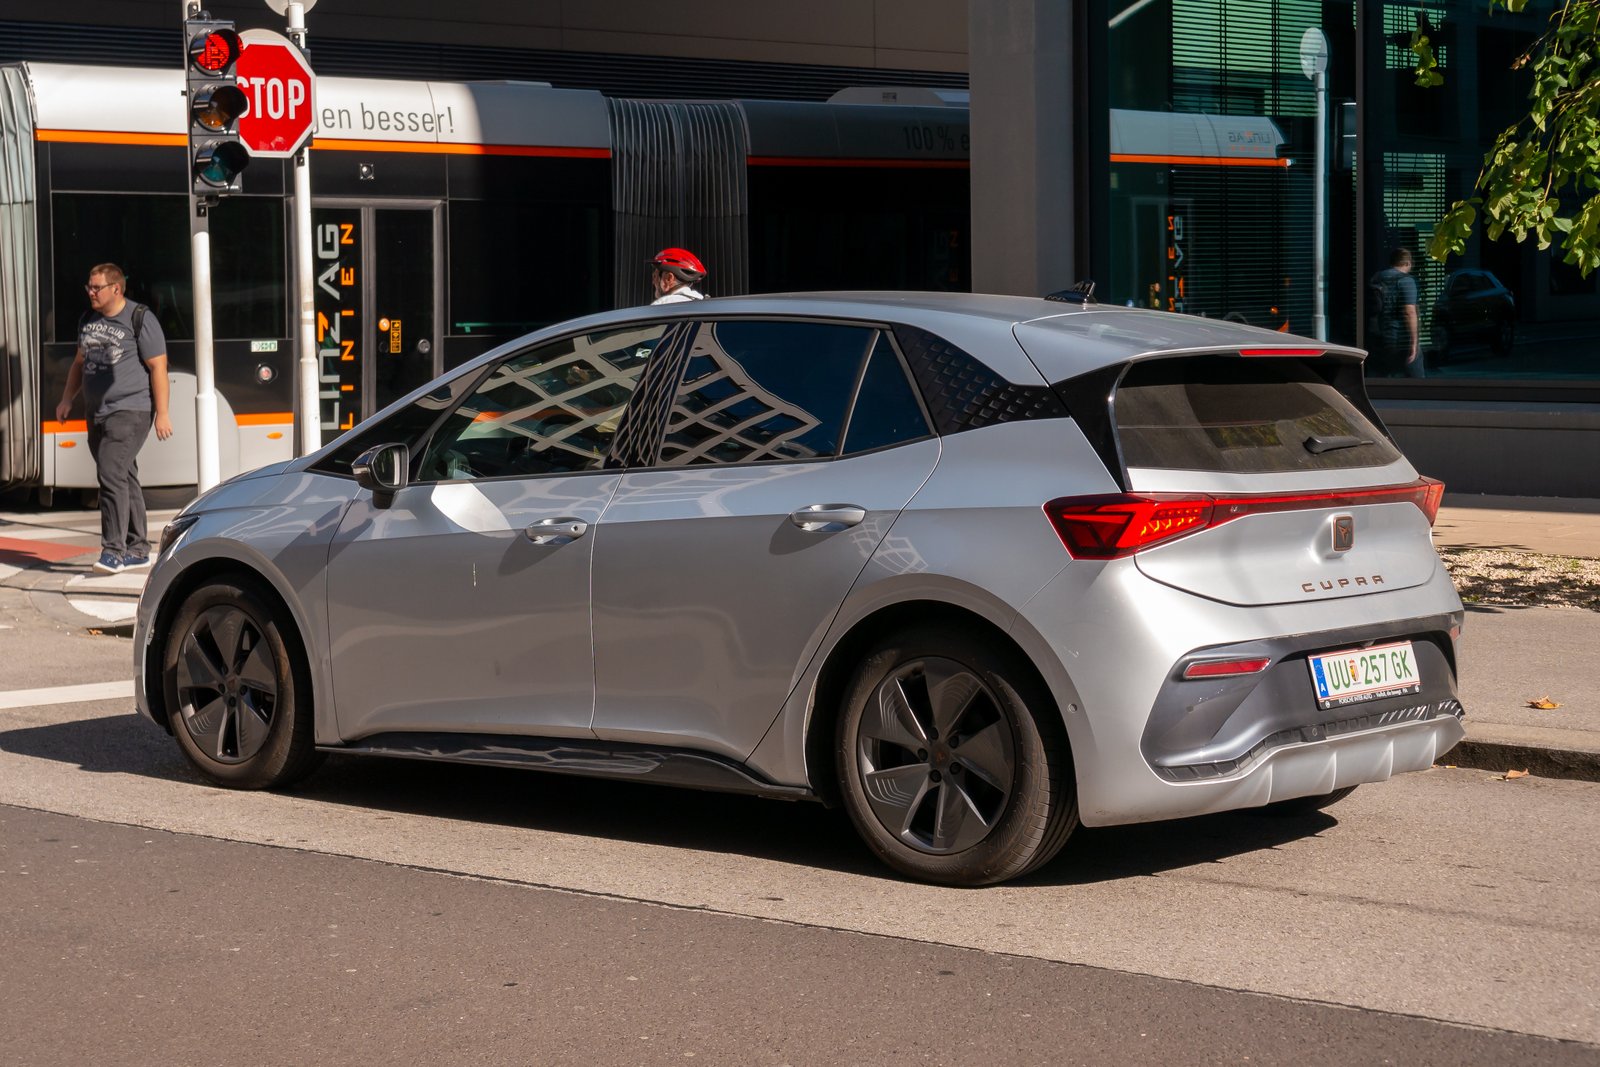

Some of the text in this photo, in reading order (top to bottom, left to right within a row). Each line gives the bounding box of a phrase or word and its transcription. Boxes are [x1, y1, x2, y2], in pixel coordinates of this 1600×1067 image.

[237, 76, 304, 119] STOP
[313, 102, 454, 134] en besser!
[903, 126, 933, 150] 100
[938, 126, 954, 151] %
[108, 326, 125, 340] CLUB
[340, 223, 354, 430] LINIEN
[1301, 575, 1384, 593] CUPRA
[1328, 650, 1413, 691] UU 257 GK
[1319, 683, 1326, 693] A
